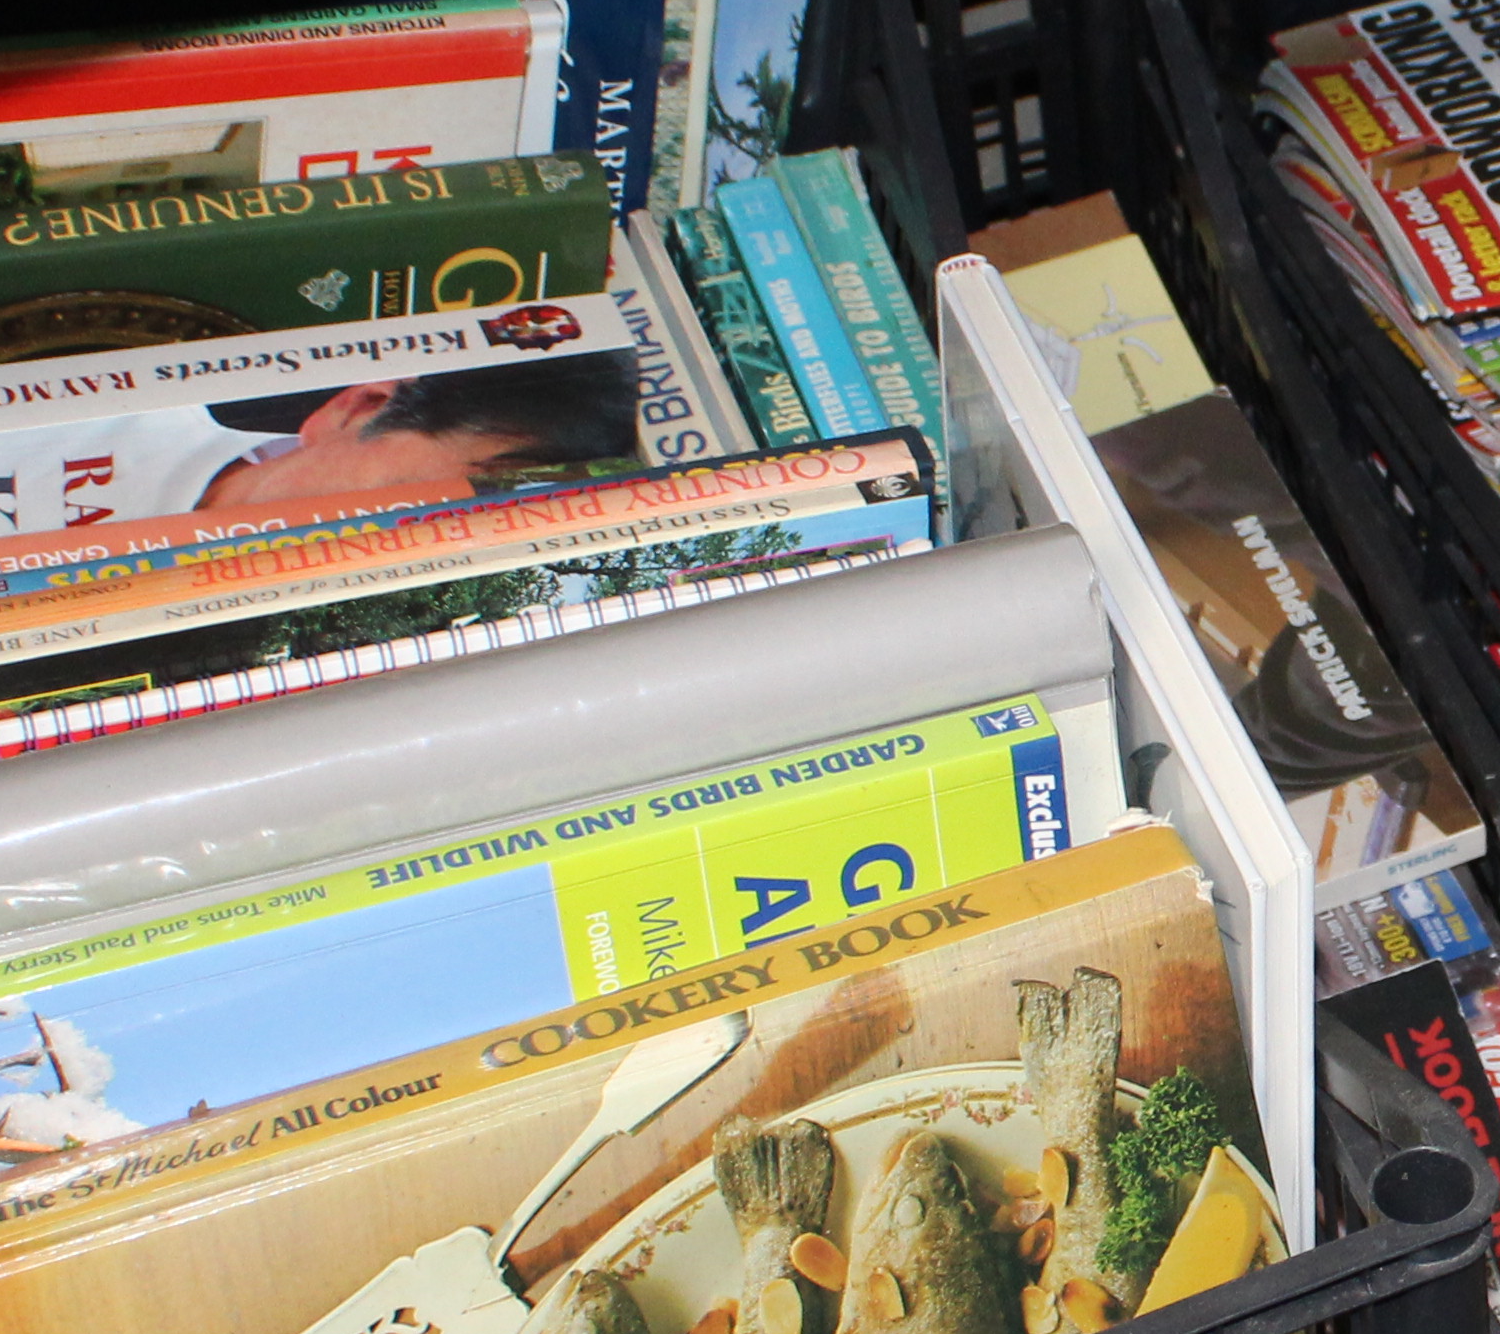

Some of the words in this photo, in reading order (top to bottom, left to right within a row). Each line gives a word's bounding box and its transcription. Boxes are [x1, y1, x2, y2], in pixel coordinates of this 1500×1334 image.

[221, 27, 294, 46] DINING
[298, 24, 344, 39] AND
[346, 16, 445, 36] KITCHENS
[1311, 67, 1392, 156] SCROLLSAW
[329, 169, 393, 210] IT
[403, 163, 454, 202] IS
[0, 173, 314, 251] GENUINE?
[1435, 188, 1481, 228] rack
[1413, 221, 1484, 303] Dovetail
[765, 277, 806, 326] MOTHS
[824, 260, 880, 323] BIRDS
[307, 323, 468, 372] Kitchen
[788, 327, 820, 357] AND
[852, 328, 895, 357] TO
[152, 345, 301, 391] Secrets
[752, 371, 812, 432] Birds
[626, 446, 867, 509] COUNTRY
[488, 488, 606, 533] PINE
[525, 495, 792, 559] Sissinghurst
[185, 509, 472, 586] FURNITURE
[334, 553, 474, 590] PORTRAIT
[1232, 508, 1318, 633] SPIELMAN
[163, 588, 279, 618] GARDEN
[31, 620, 101, 645] JANE
[1297, 620, 1373, 726] PATRICK
[768, 730, 925, 783] GARDEN
[646, 772, 762, 819] BIRDS
[552, 803, 638, 843] AND
[364, 826, 548, 891] WILDLIFE
[193, 898, 262, 930] Toms
[265, 883, 327, 912] Mike
[81, 931, 136, 960] Paul
[141, 917, 189, 944] and
[1, 944, 77, 979] Sterry
[265, 1103, 323, 1142] All
[322, 1065, 448, 1125] Colour
[475, 952, 786, 1075] COOKERY
[796, 888, 994, 976] BOOK
